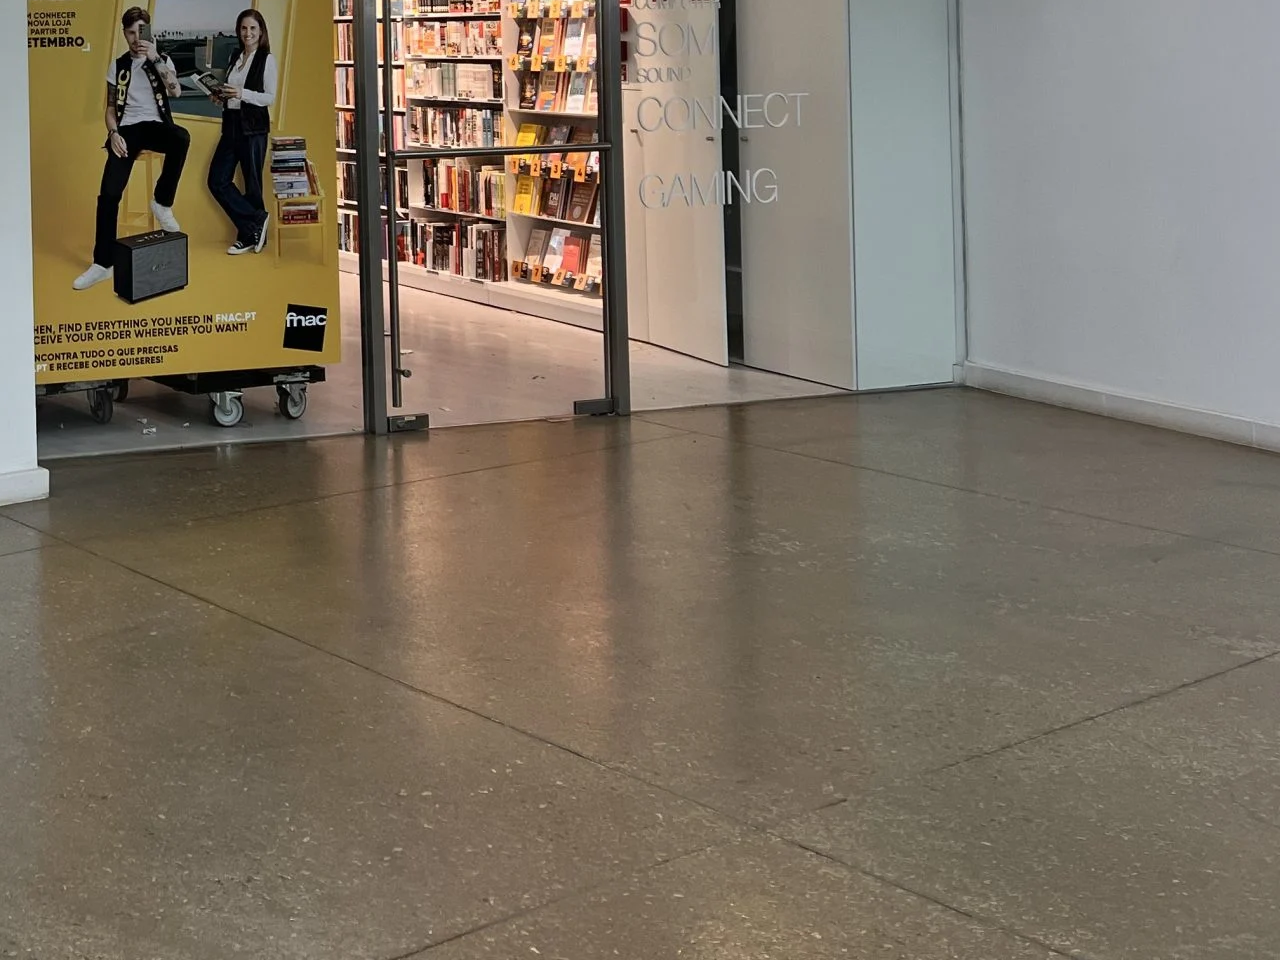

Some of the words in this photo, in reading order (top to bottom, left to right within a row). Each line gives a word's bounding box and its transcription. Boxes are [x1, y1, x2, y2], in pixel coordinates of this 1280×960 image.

[51, 19, 72, 27] LOJA
[28, 36, 85, 48] ETEMBRO
[636, 21, 718, 57] SOM
[637, 92, 810, 133] CONNECT
[638, 168, 779, 209] GAMING
[34, 325, 55, 335] HEN,
[58, 323, 82, 333] FIND
[85, 318, 148, 331] EVERYTHING
[150, 317, 172, 327] YOU
[174, 315, 200, 325] NEED
[203, 314, 213, 324] IN
[215, 312, 257, 323] FNAC.PT
[285, 312, 328, 328] fnac
[34, 334, 62, 345] CEIVE
[65, 332, 94, 343] YOUR
[96, 330, 132, 341] ORDER
[133, 326, 189, 338] WHEREVER
[192, 324, 213, 335] YOU
[214, 322, 248, 333] WANT!
[35, 351, 78, 363] NCONTRA
[80, 349, 105, 359] TUDO
[107, 349, 115, 357] O
[116, 348, 135, 358] QUE
[137, 344, 179, 355] PRECISAS
[49, 363, 55, 371] E
[56, 360, 90, 371] RECEBE
[91, 359, 117, 368] ONDE
[119, 356, 164, 367] QUISERES!
